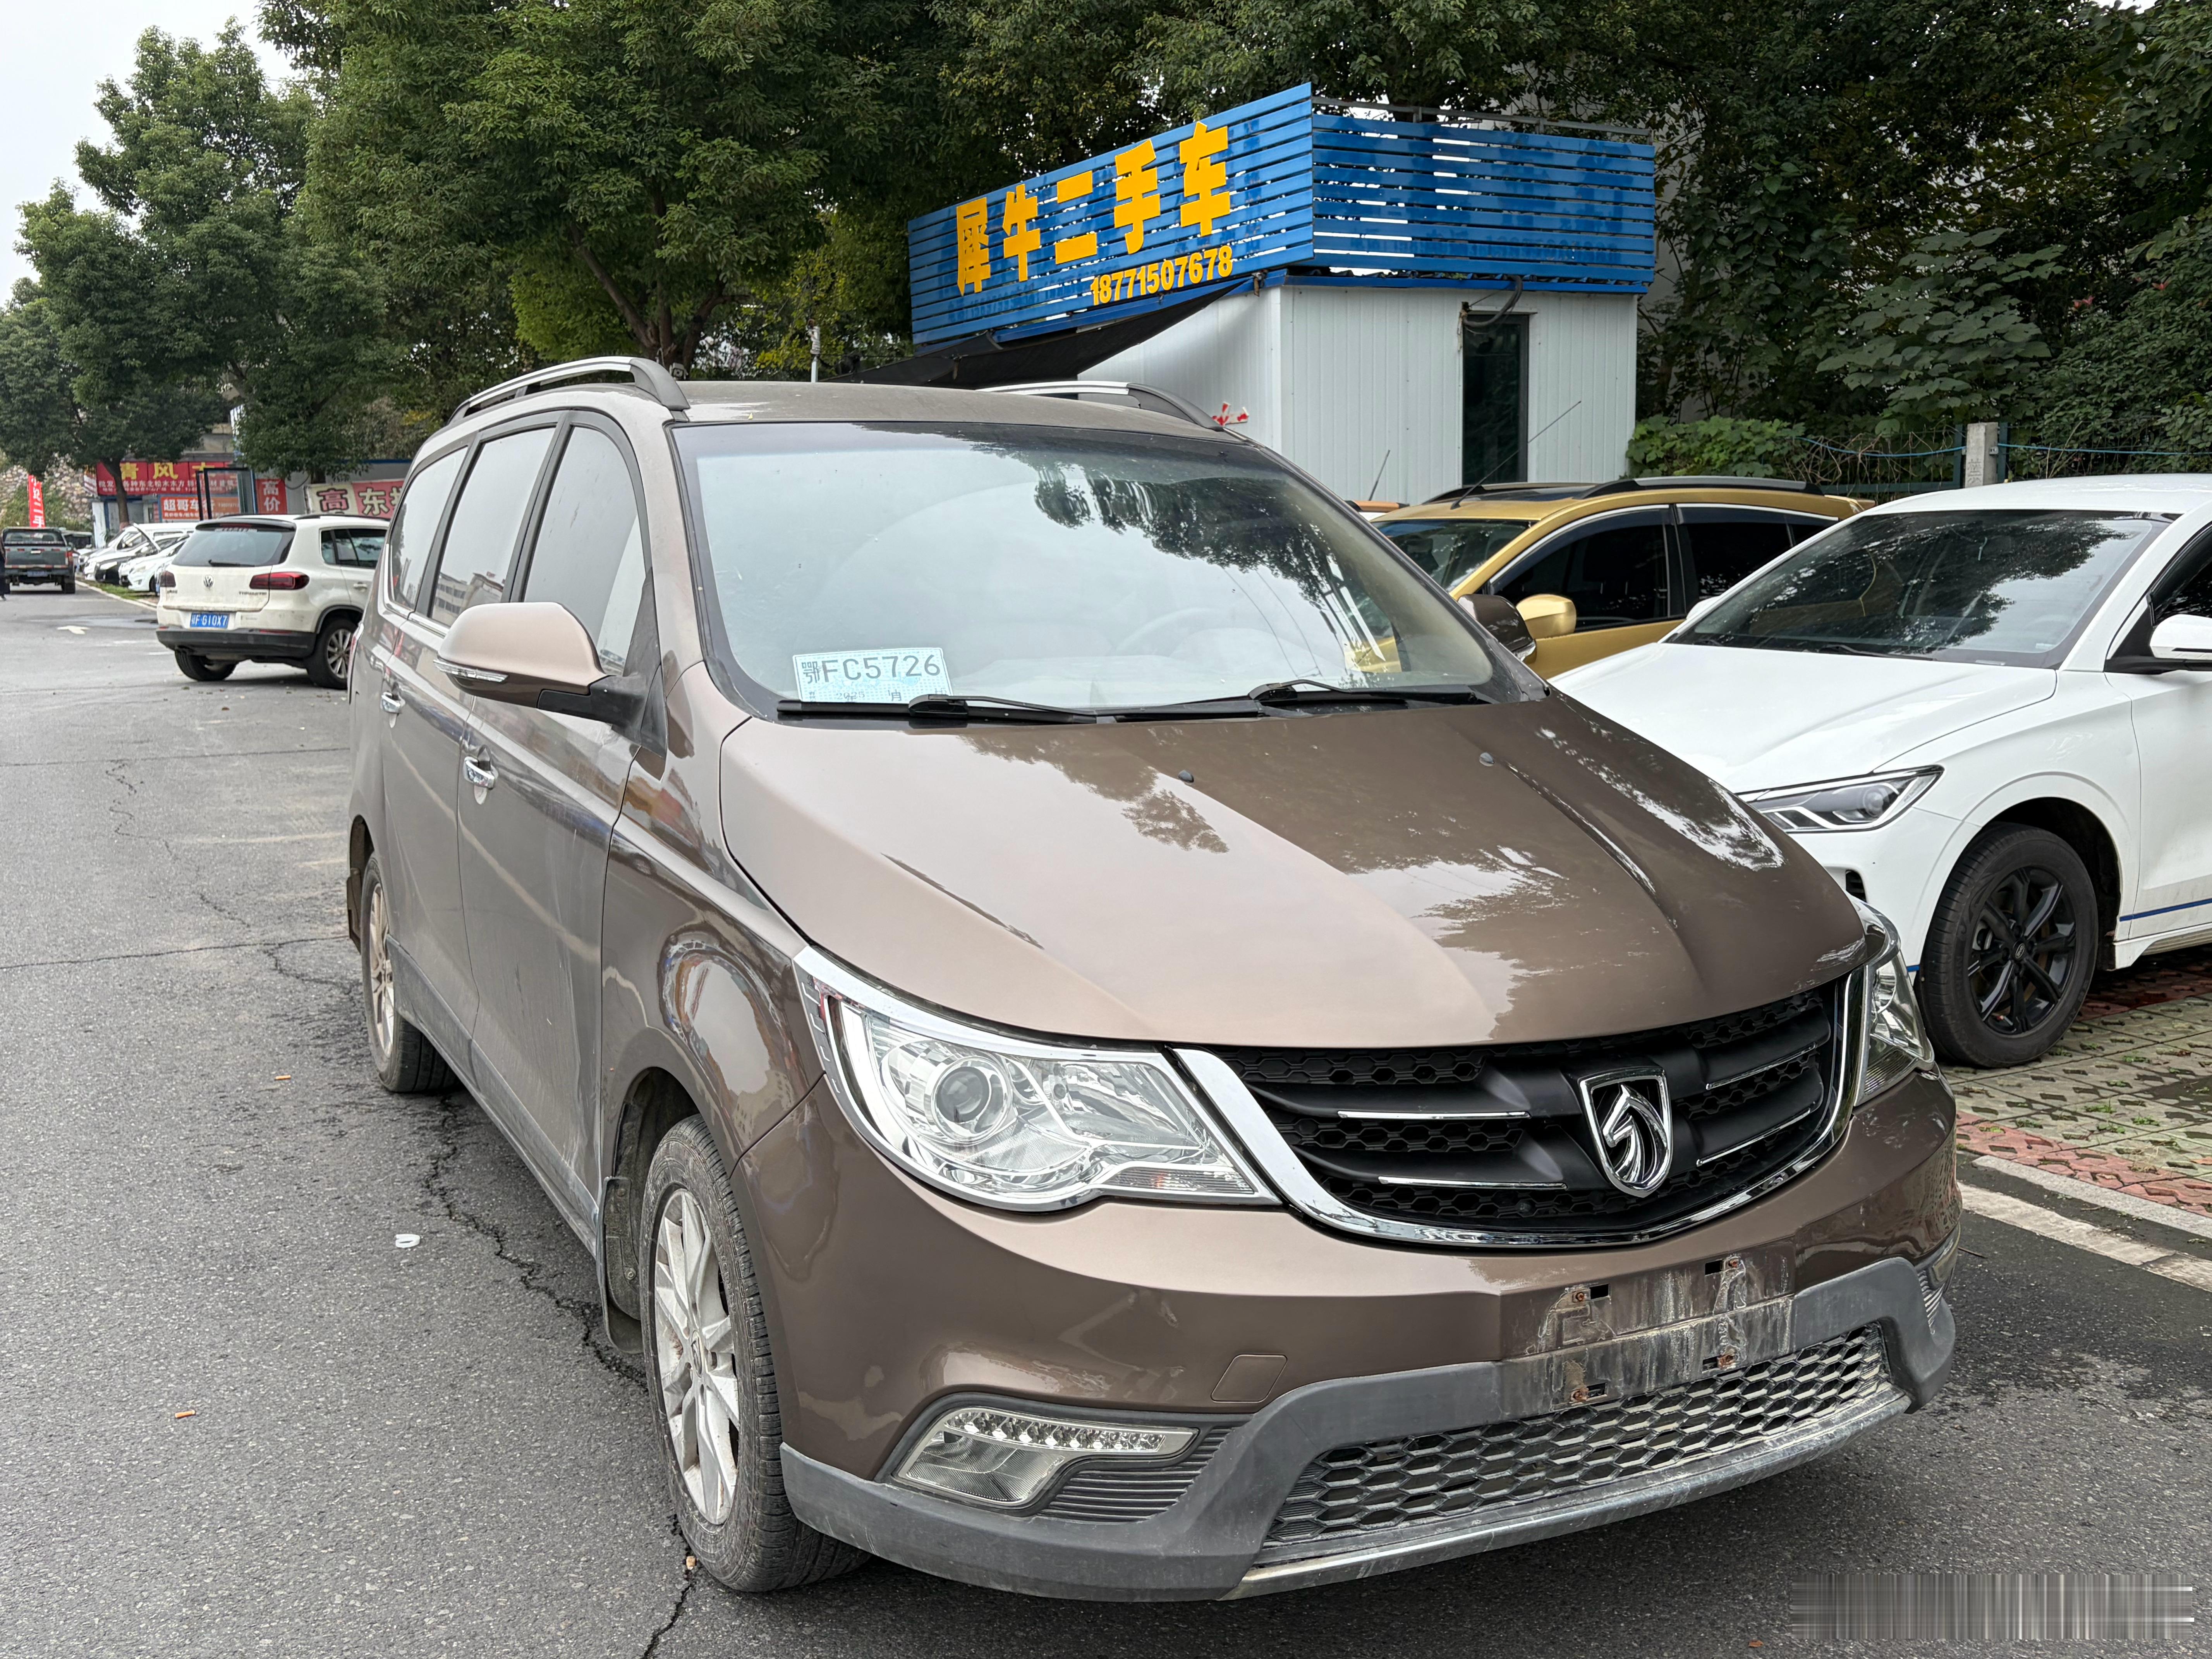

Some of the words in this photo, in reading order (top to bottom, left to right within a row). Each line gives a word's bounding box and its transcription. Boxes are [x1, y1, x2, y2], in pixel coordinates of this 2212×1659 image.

[957, 121, 1230, 296] 犀牛二手车
[1091, 245, 1233, 306] 18771507678
[262, 481, 280, 512] 高价
[317, 488, 349, 514] 高
[802, 654, 940, 684] 鄂FC5726
